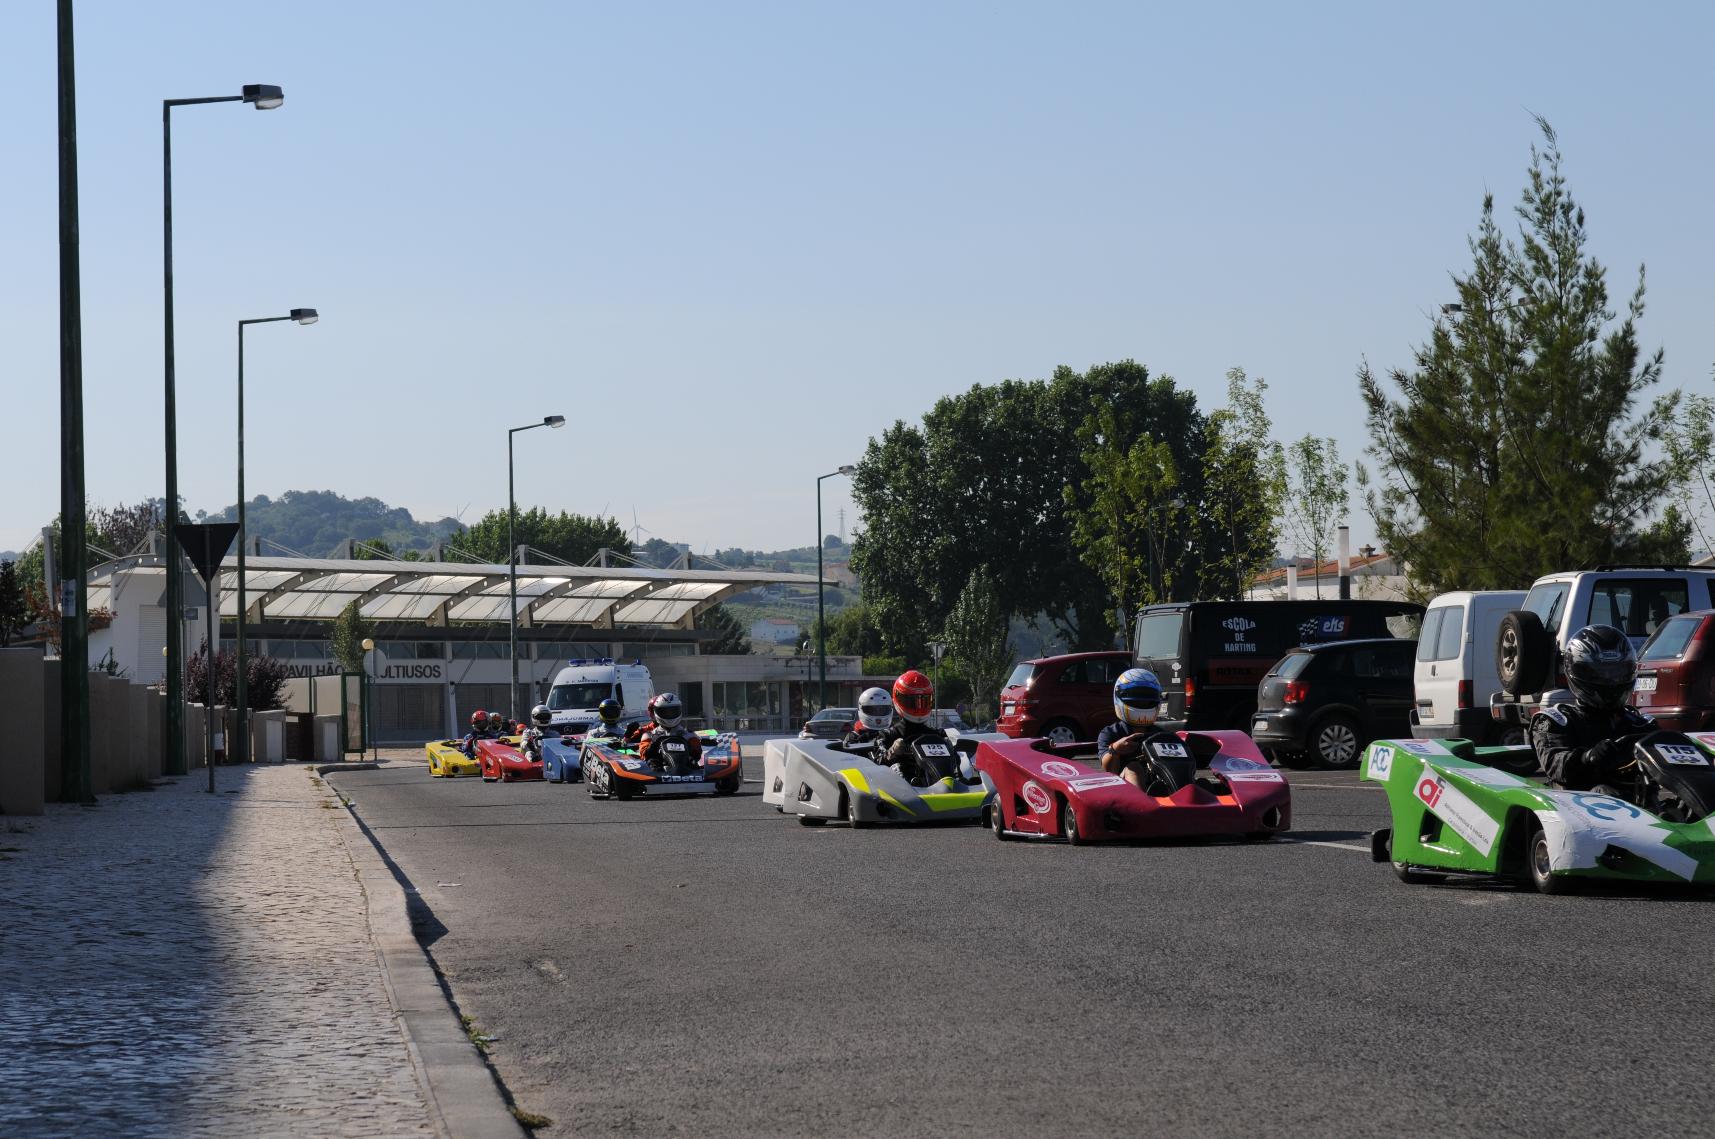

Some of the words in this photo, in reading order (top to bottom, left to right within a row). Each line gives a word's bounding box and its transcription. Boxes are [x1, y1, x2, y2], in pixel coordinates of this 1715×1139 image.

[1222, 617, 1256, 631] ESCOLA
[1234, 632, 1245, 642] DE
[1224, 643, 1256, 652] KARTING
[378, 664, 441, 678] ULTIUSOS
[1160, 743, 1179, 751] 10
[1661, 745, 1696, 755] 115
